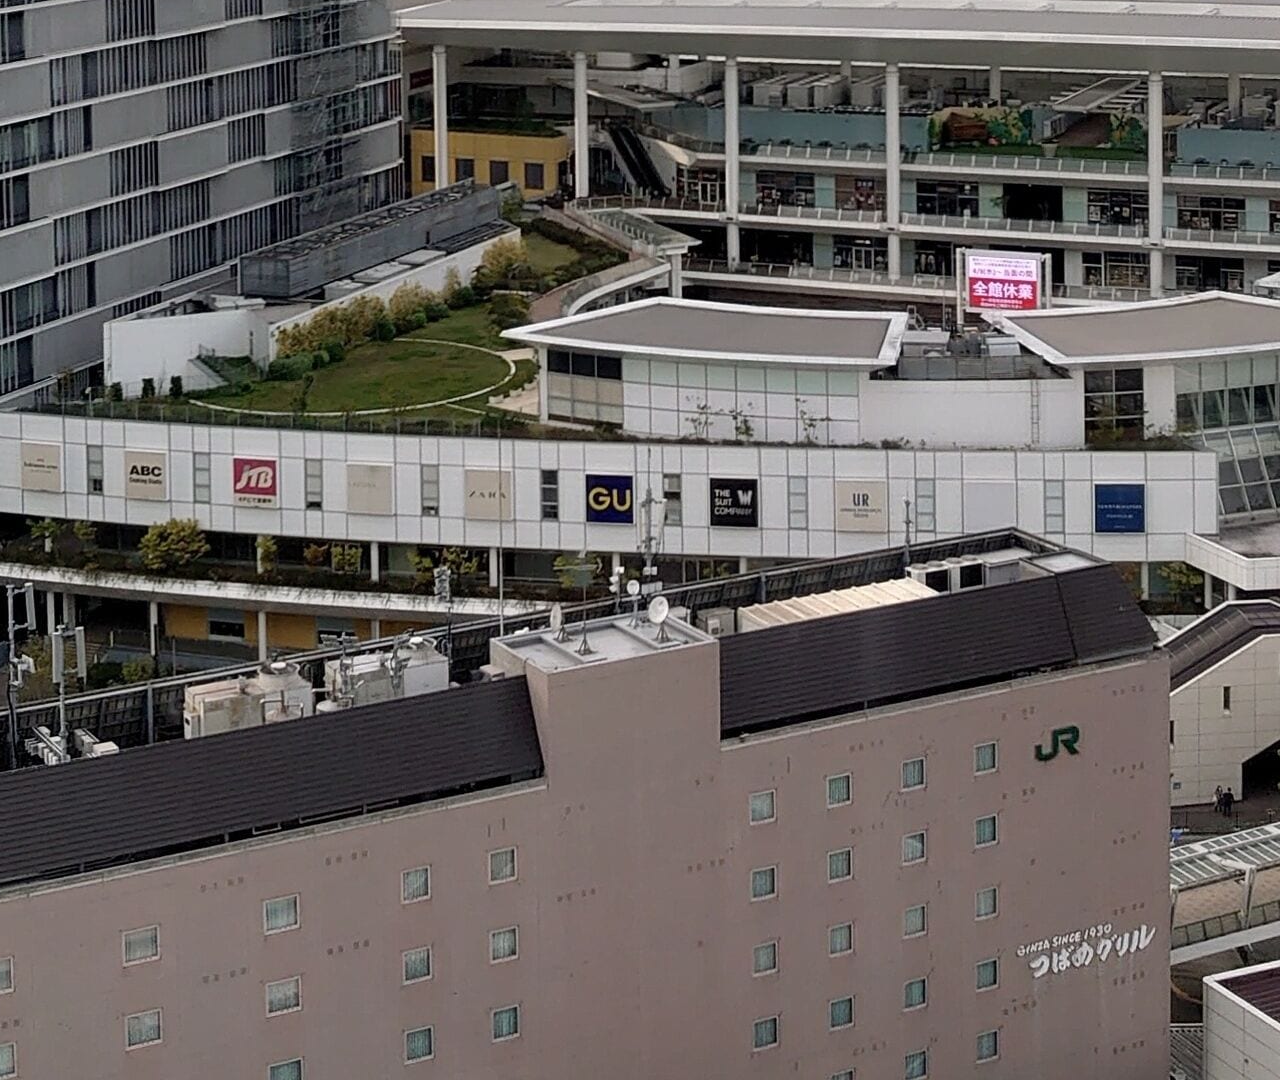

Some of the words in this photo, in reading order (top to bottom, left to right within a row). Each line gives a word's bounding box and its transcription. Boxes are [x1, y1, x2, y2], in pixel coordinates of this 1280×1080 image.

[972, 281, 1034, 300] 全館休業
[130, 465, 163, 477] ABC
[236, 465, 273, 490] JTB
[588, 487, 631, 512] GU
[714, 489, 731, 498] THE
[714, 498, 733, 506] SUIT
[853, 493, 870, 507] UR
[1034, 725, 1080, 762] JR
[1017, 938, 1051, 957] GINZA
[1051, 931, 1082, 948] SINCE
[1083, 923, 1112, 940] 1930
[1029, 924, 1156, 978] つばめグリル
